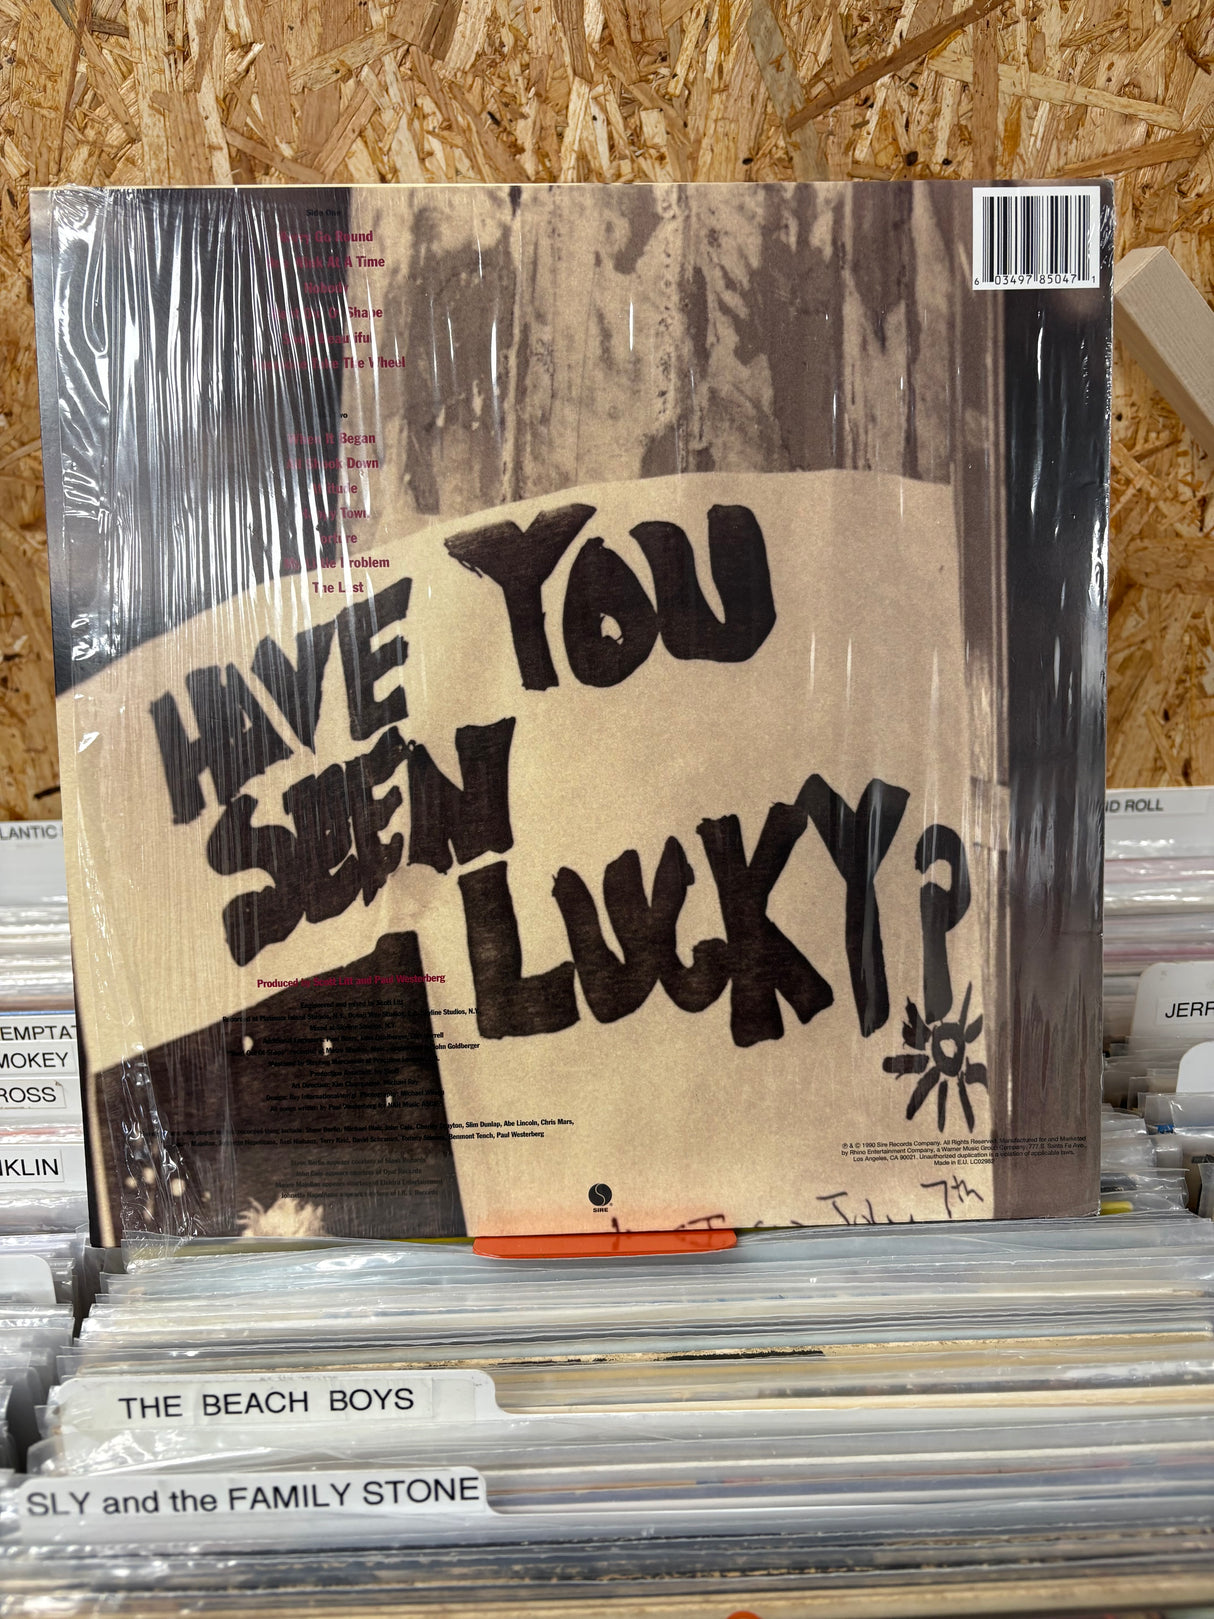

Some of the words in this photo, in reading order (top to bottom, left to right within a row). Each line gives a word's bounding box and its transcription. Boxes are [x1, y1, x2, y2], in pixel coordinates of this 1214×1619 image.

[314, 231, 331, 242] Go
[335, 230, 373, 242] Round
[345, 256, 353, 267] A
[356, 255, 385, 267] Time
[994, 274, 1033, 285] 03497
[1039, 273, 1077, 284] 85047
[304, 282, 349, 295] Nobody
[326, 433, 334, 444] It
[340, 432, 376, 446] Began
[347, 457, 379, 469] Down
[149, 577, 413, 826] HAVE
[445, 503, 777, 691] YOU
[1125, 798, 1164, 812] ROLL
[206, 717, 516, 966] SEEN
[257, 979, 298, 988] Produced
[301, 979, 312, 989] by
[313, 977, 337, 987] Scott
[356, 976, 371, 985] and
[374, 975, 394, 984] Paul
[396, 973, 446, 984] Westerberg
[447, 1042, 480, 1051] Goldberger
[480, 1120, 502, 1129] Dunlap,
[516, 1119, 539, 1128] Lincoln,
[557, 1119, 575, 1127] Mars,
[476, 1132, 495, 1140] Tench,
[511, 1131, 545, 1139] Westerberg
[865, 1155, 889, 1163] Angeles,
[919, 1152, 957, 1160] Unauthorized
[957, 1153, 989, 1161] duplication
[919, 1175, 985, 1219] 7th
[119, 1395, 182, 1419] THE
[203, 1390, 309, 1416] BEACH
[329, 1388, 415, 1412] BOYS
[26, 1492, 91, 1517] SLY
[103, 1491, 160, 1514] and
[171, 1488, 218, 1512] the
[229, 1483, 352, 1511] FAMILY
[363, 1476, 480, 1505] STONE
